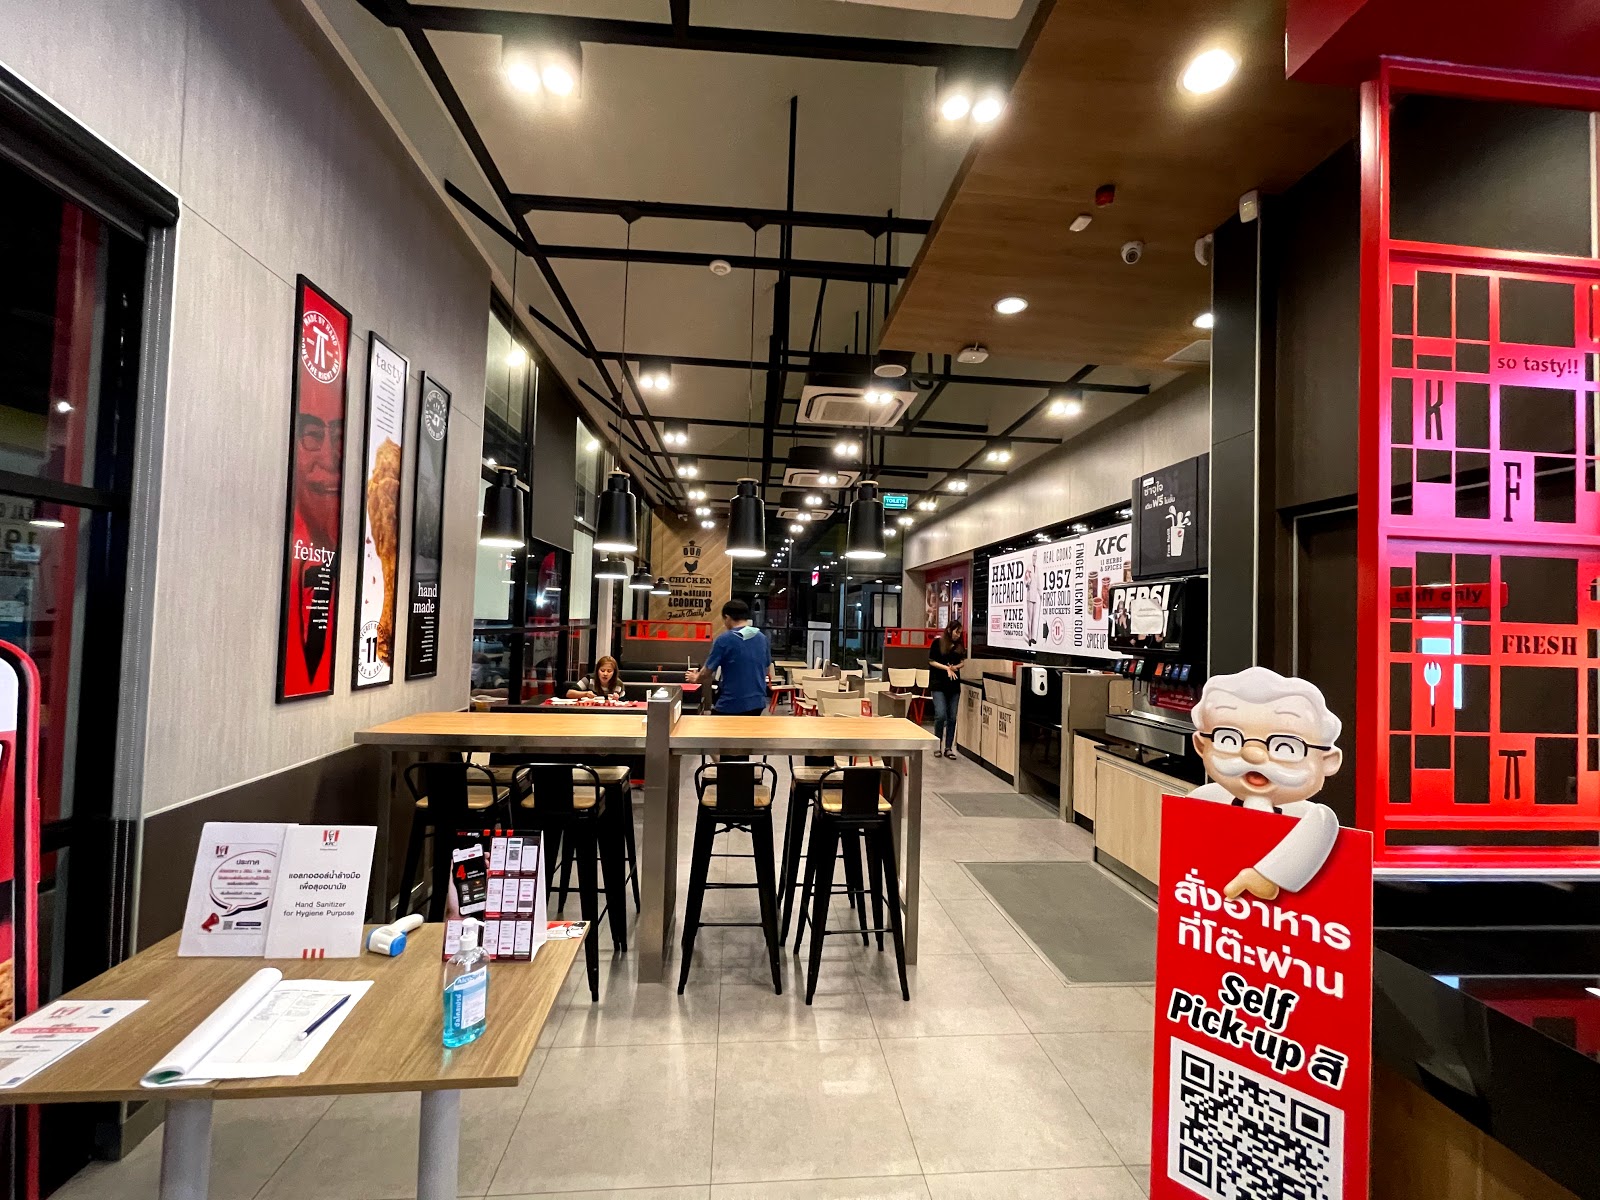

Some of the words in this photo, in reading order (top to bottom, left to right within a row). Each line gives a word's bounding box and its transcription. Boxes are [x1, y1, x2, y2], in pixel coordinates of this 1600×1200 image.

[325, 324, 338, 346] HAND
[307, 360, 318, 375] THE
[318, 371, 333, 381] RIGHT
[376, 353, 403, 384] tasty
[1497, 357, 1517, 369] so
[1523, 356, 1578, 378] tasty!!
[1425, 379, 1443, 440] K
[1503, 461, 1521, 522] F
[294, 539, 335, 567] feisty
[683, 547, 701, 557] OUR
[1094, 533, 1128, 557] KFC
[1043, 550, 1054, 564] REAL
[1056, 546, 1072, 562] COOKS
[1075, 543, 1085, 579] FINGER
[1106, 556, 1123, 565] HERBS
[992, 560, 1024, 582] HAND
[1105, 563, 1123, 571] SPICES
[417, 581, 438, 598] hand
[669, 577, 712, 585] CHICKEN
[1042, 569, 1072, 591] 1957
[991, 581, 1024, 604] PREPARED
[1042, 591, 1056, 607] FIRST
[1058, 590, 1071, 606] SOLD
[1441, 587, 1482, 603] only
[413, 598, 435, 613] made
[1004, 608, 1024, 621] VINE
[1049, 607, 1071, 615] BUCKETS
[1003, 622, 1024, 630] RIPENED
[1073, 619, 1083, 647] GOOD
[366, 637, 377, 663] 11
[1087, 633, 1099, 649] SPICE
[1100, 633, 1107, 649] UP
[1500, 634, 1577, 656] FRESH
[999, 720, 1007, 733] BIN
[1000, 711, 1011, 723] WASTE
[456, 864, 466, 880] 4
[299, 881, 347, 892] เพื่อสุขอนามัย
[295, 901, 314, 909] Hand
[296, 910, 323, 918] Hygiene
[327, 910, 355, 918] Purpose
[1174, 869, 1351, 950] สั่งอาหาร
[1178, 912, 1344, 998] ที่โต๊ะผ่าน
[1223, 974, 1297, 1032] Self
[1169, 988, 1305, 1074] Pick-up
